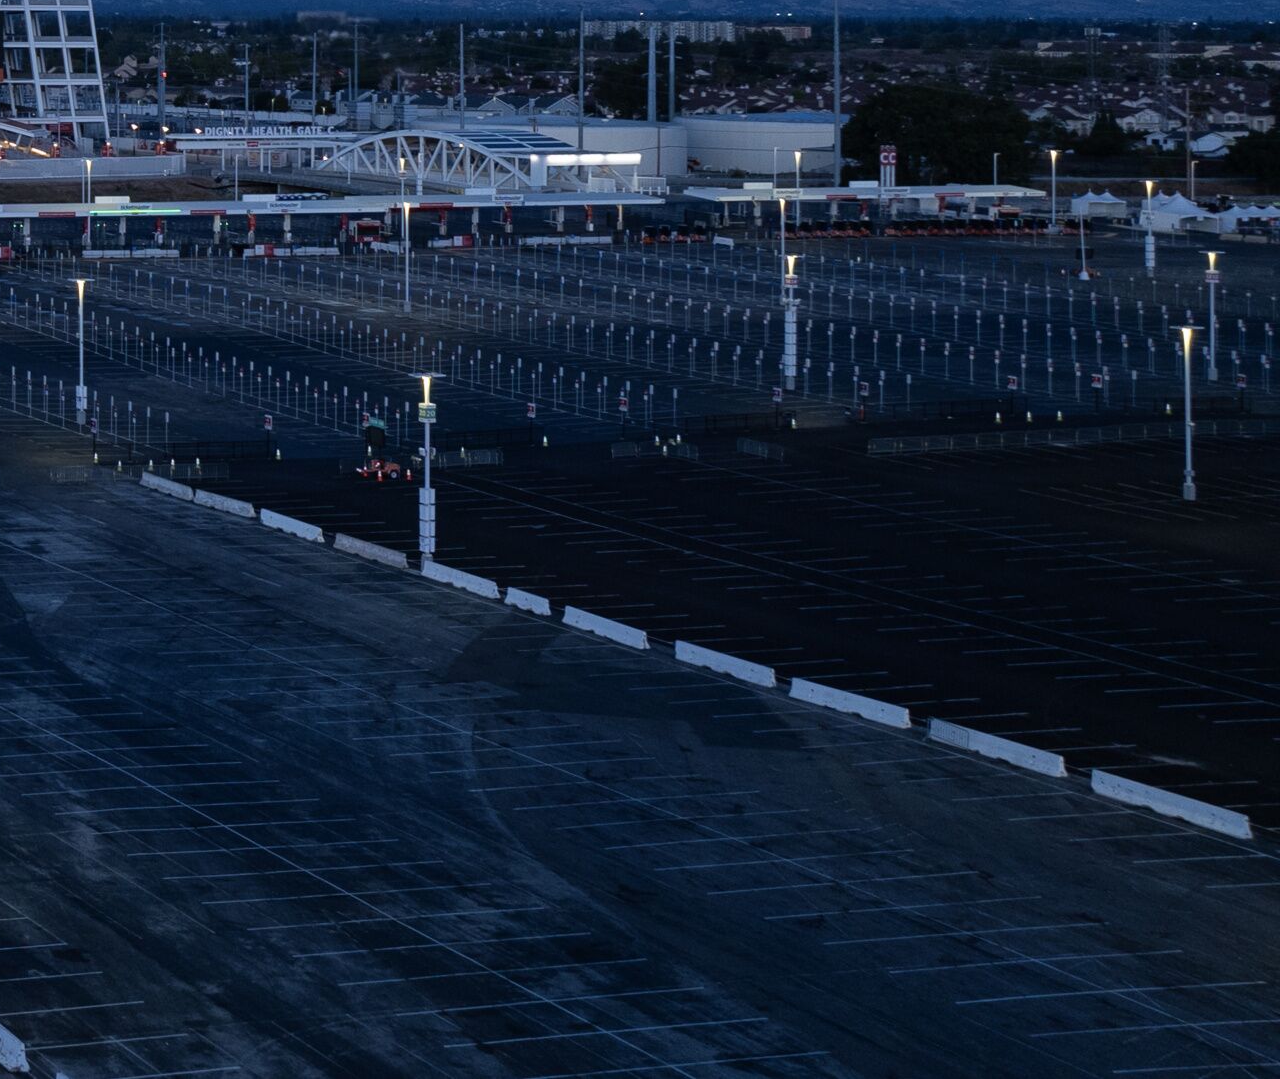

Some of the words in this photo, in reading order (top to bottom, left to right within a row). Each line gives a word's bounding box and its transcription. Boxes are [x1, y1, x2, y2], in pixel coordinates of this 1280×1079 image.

[204, 126, 248, 136] DIGNITY
[252, 126, 292, 136] HEALTH
[296, 126, 323, 136] GATE
[327, 126, 336, 135] C
